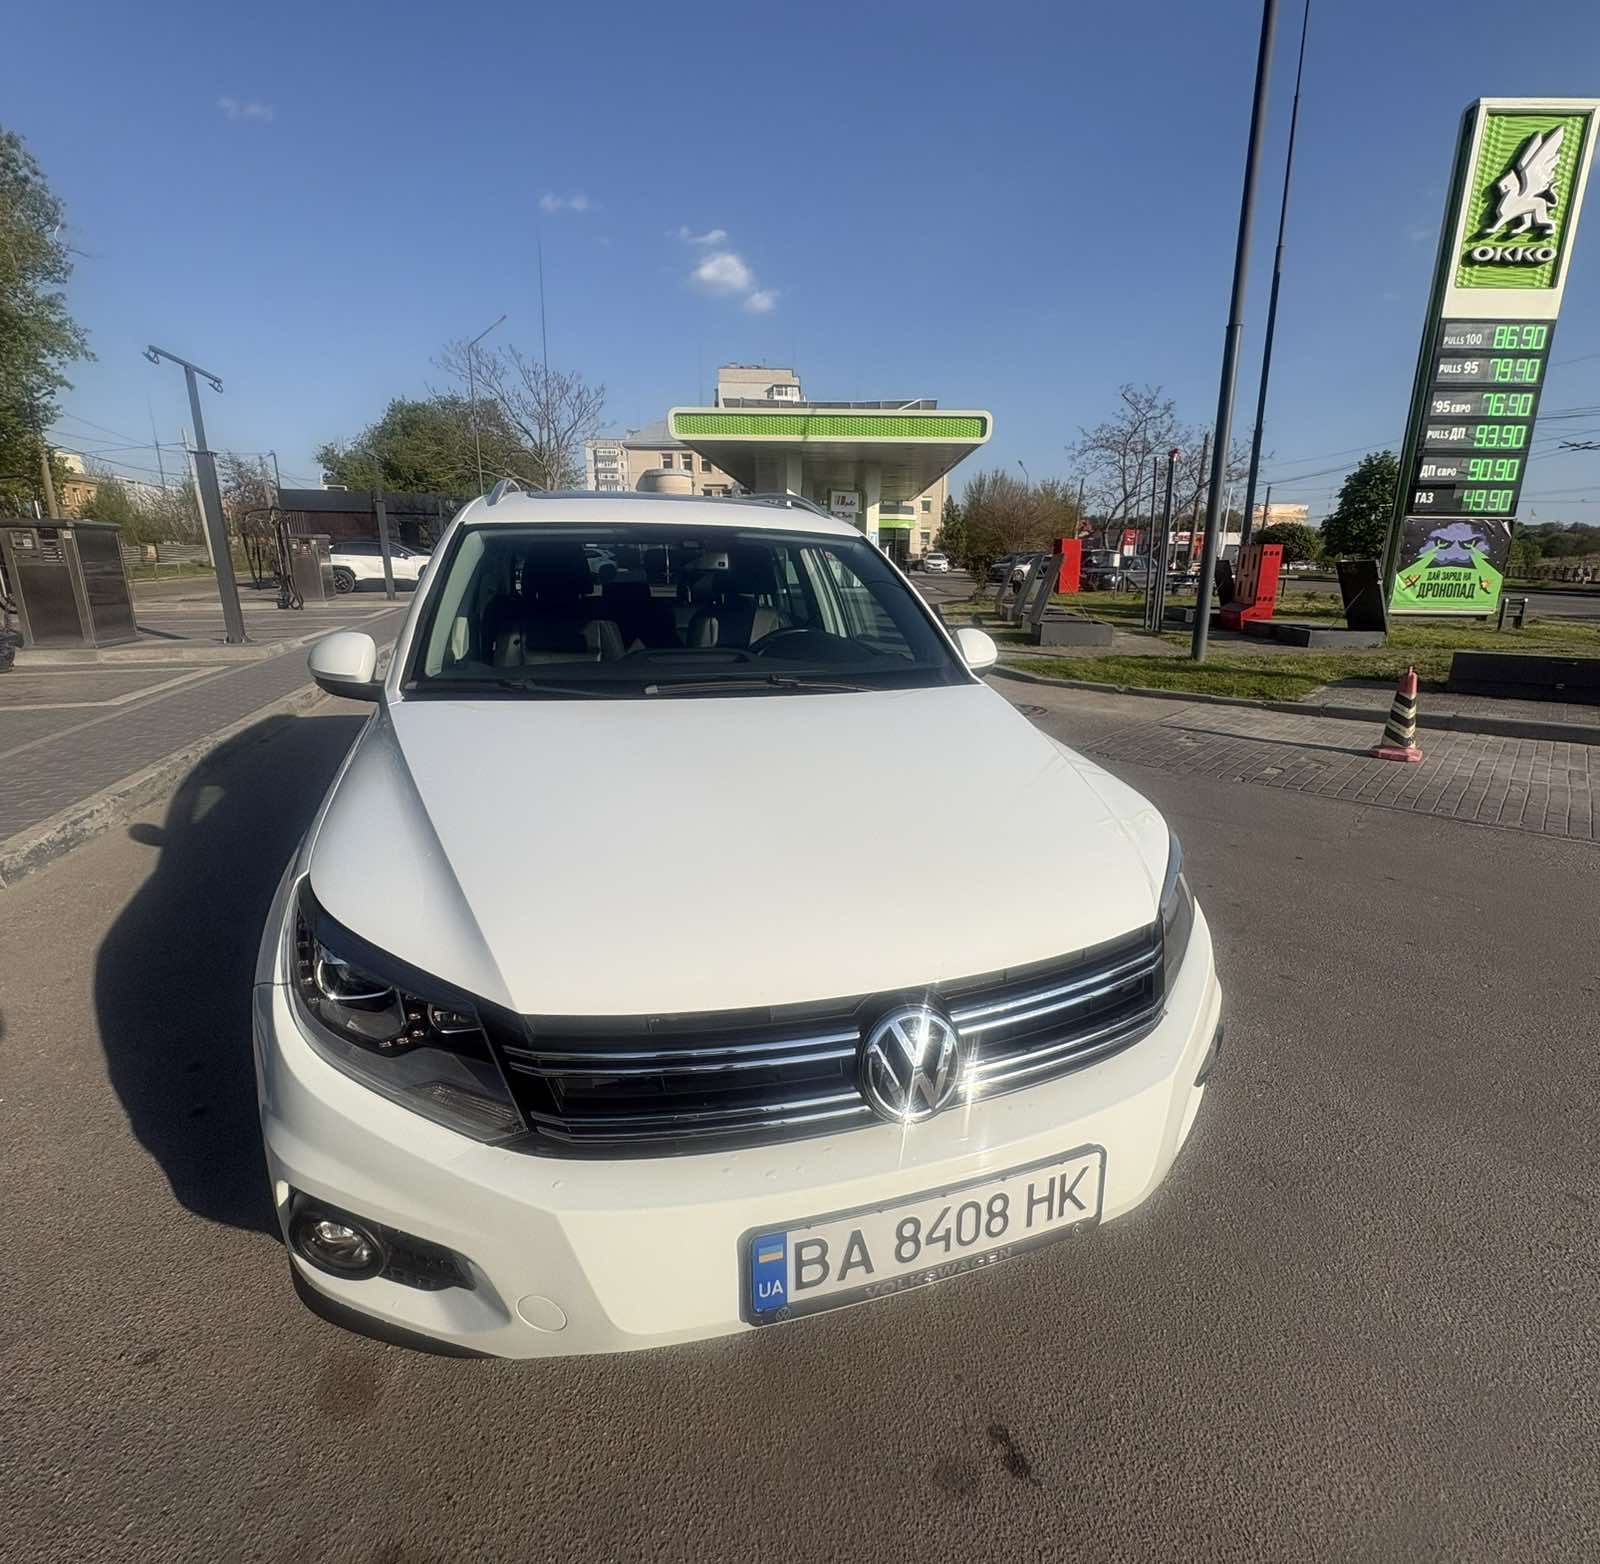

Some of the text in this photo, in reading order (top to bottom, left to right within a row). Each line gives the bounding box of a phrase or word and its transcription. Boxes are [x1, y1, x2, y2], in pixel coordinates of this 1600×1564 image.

[1472, 245, 1557, 263] OKKO
[1443, 325, 1548, 350] PULLS 100 86.90
[1438, 358, 1541, 382] PULLS 95 79.90
[1483, 393, 1534, 417] 76.90
[1426, 425, 1527, 447] PULLS ДП 93.90
[1420, 465, 1436, 478] ДП
[1467, 459, 1520, 481] 90.90
[1414, 489, 1514, 511] ГАЗ 49.90
[1427, 570, 1440, 581] ДАЙ
[1463, 572, 1472, 581] НА
[1416, 583, 1476, 599] ДРОНОПАД
[794, 1166, 1090, 1291] BA 8408 HK
[759, 1279, 784, 1298] UA
